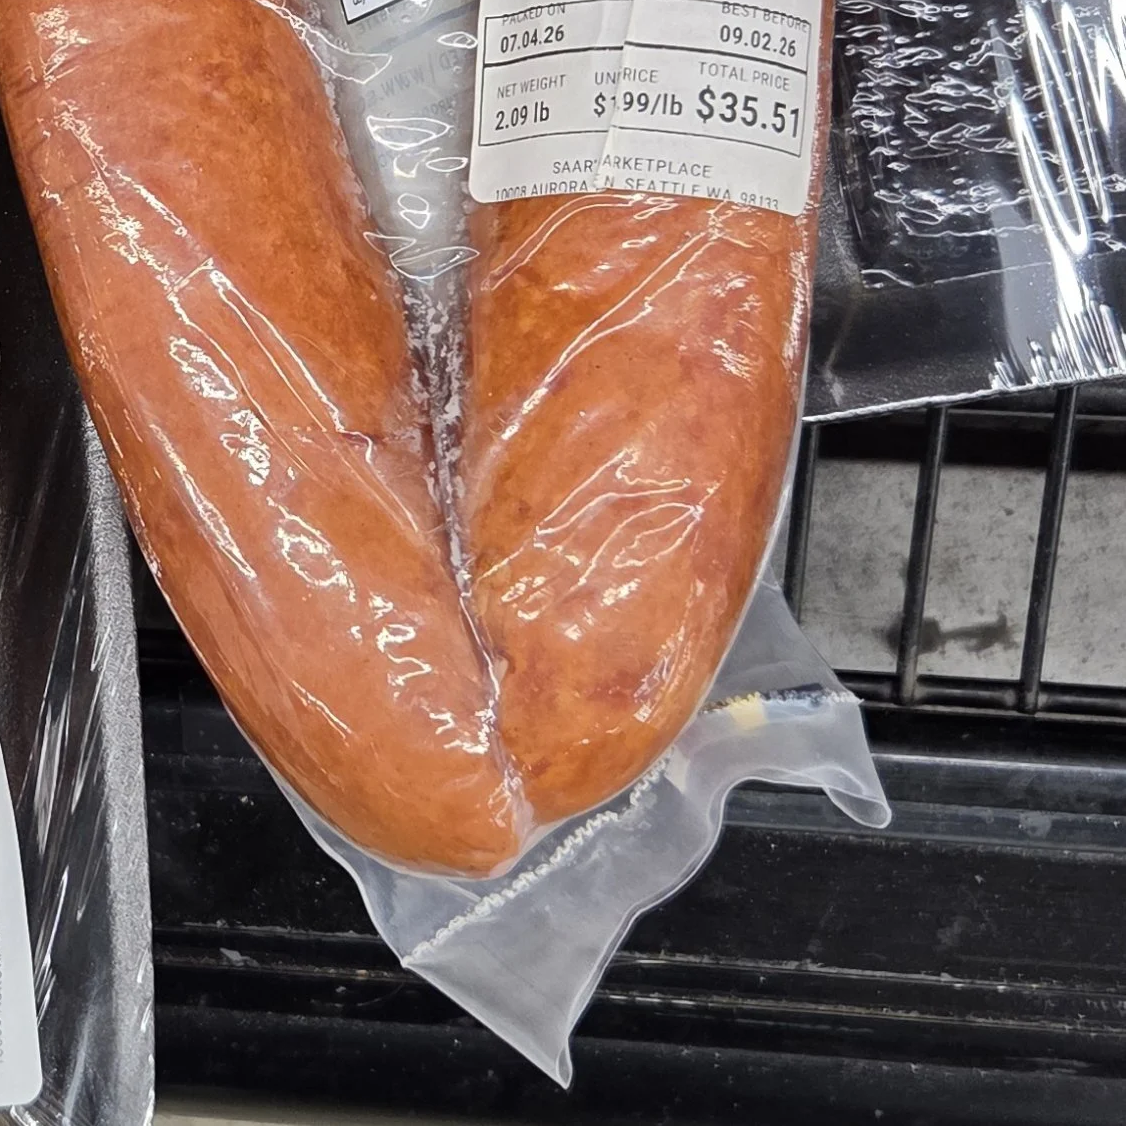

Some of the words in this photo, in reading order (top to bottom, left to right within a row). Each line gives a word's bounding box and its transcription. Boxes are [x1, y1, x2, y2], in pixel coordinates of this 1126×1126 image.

[547, 2, 566, 16] ON
[721, 1, 760, 18] BEST
[762, 7, 810, 33] BEFORE
[500, 25, 565, 53] 07.04.26
[719, 25, 797, 57] 09.02.26
[497, 85, 518, 100] NET
[521, 74, 567, 93] WEIGHT
[623, 69, 659, 84] RICE
[698, 61, 747, 82] TOTAL
[753, 71, 790, 91] PRICE
[496, 106, 528, 131] 2.09
[533, 105, 550, 123] lb
[696, 85, 801, 138] $35.51
[602, 154, 713, 179] ARKETPLACE
